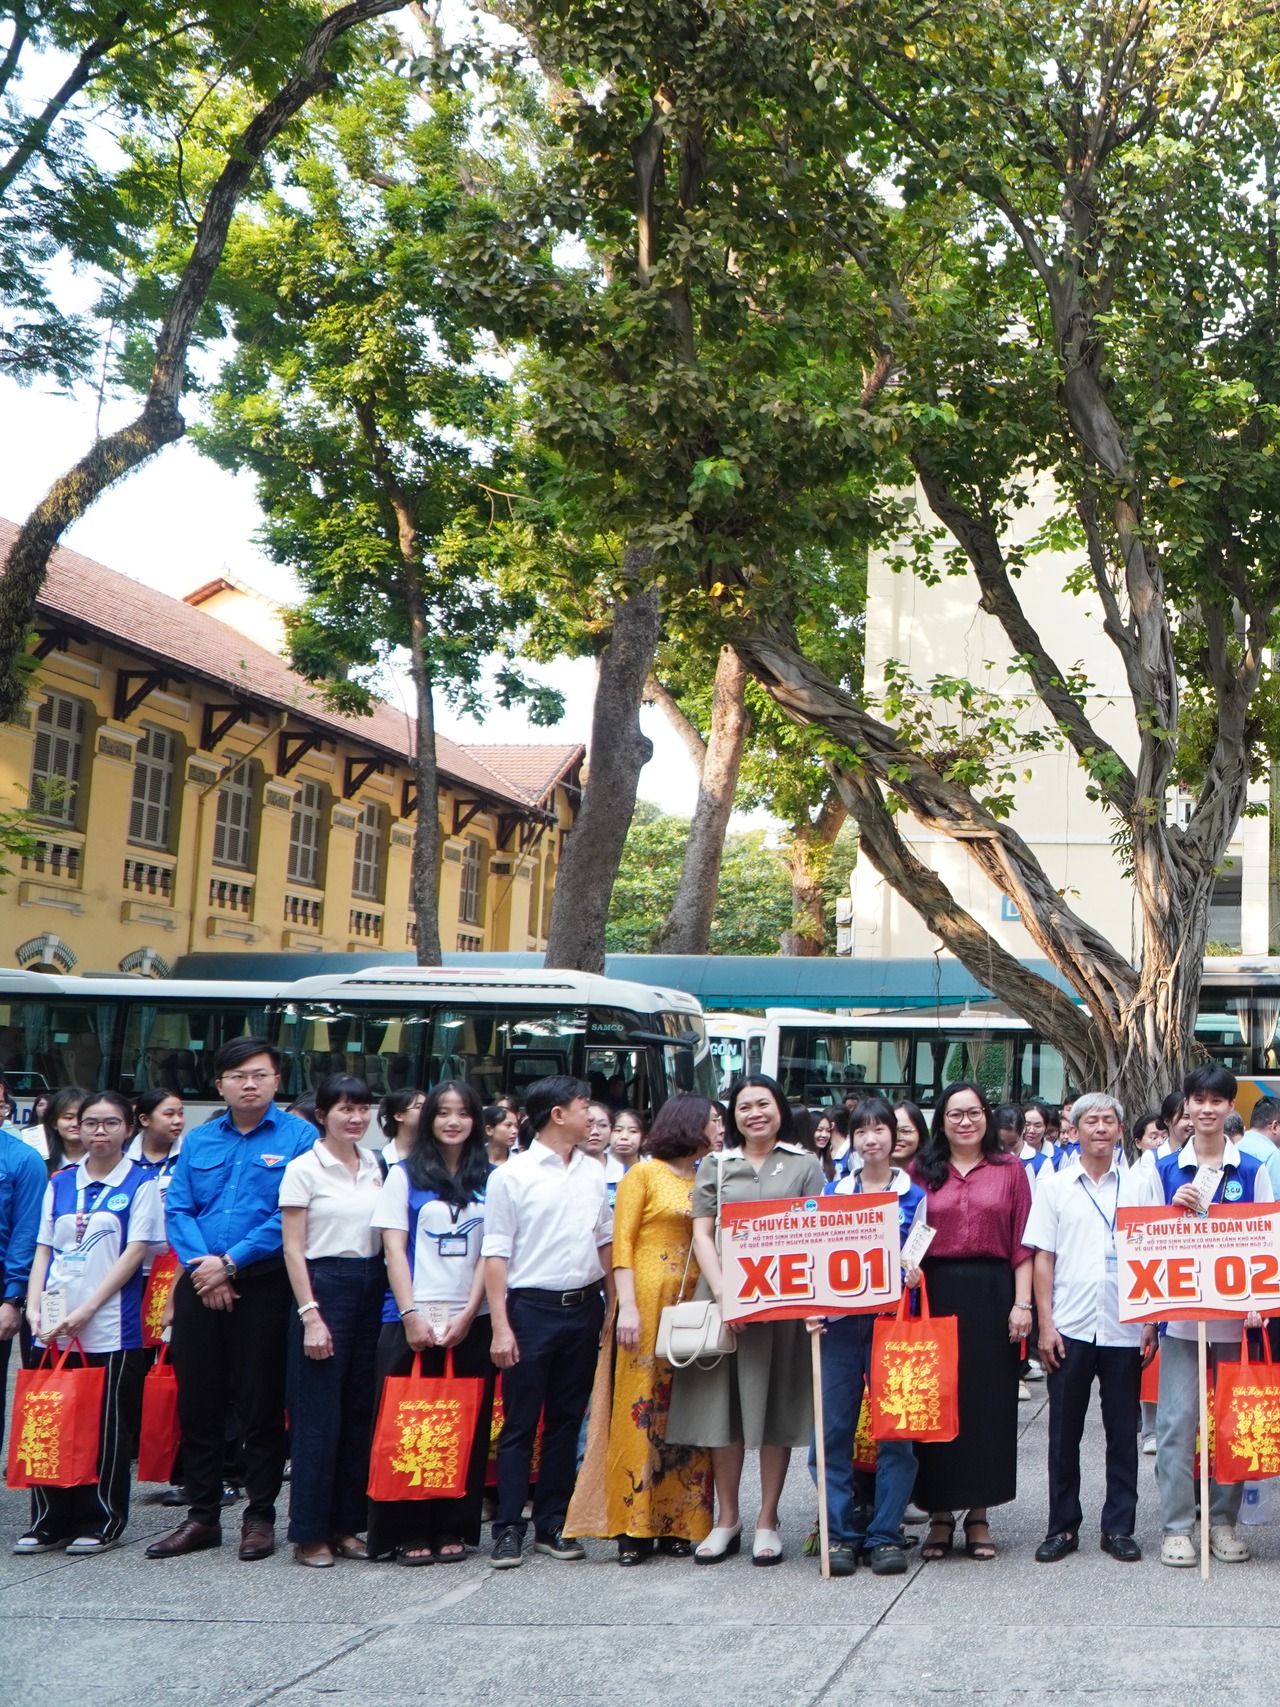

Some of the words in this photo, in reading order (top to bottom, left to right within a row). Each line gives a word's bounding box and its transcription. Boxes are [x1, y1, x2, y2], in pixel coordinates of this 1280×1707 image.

[591, 1023, 624, 1032] SAMCO
[752, 1212, 798, 1232] CHUYẾN
[802, 1216, 816, 1228] XE
[820, 1211, 852, 1227] ĐOÀN
[856, 1209, 883, 1224] VIÊN
[1146, 1218, 1191, 1235] CHUYẾN
[1194, 1222, 1208, 1234] XE
[1211, 1218, 1243, 1233] ĐOÀN
[1246, 1218, 1272, 1232] VIÊN
[736, 1252, 813, 1300] XE
[827, 1247, 888, 1294] 01
[1126, 1258, 1199, 1302] XE
